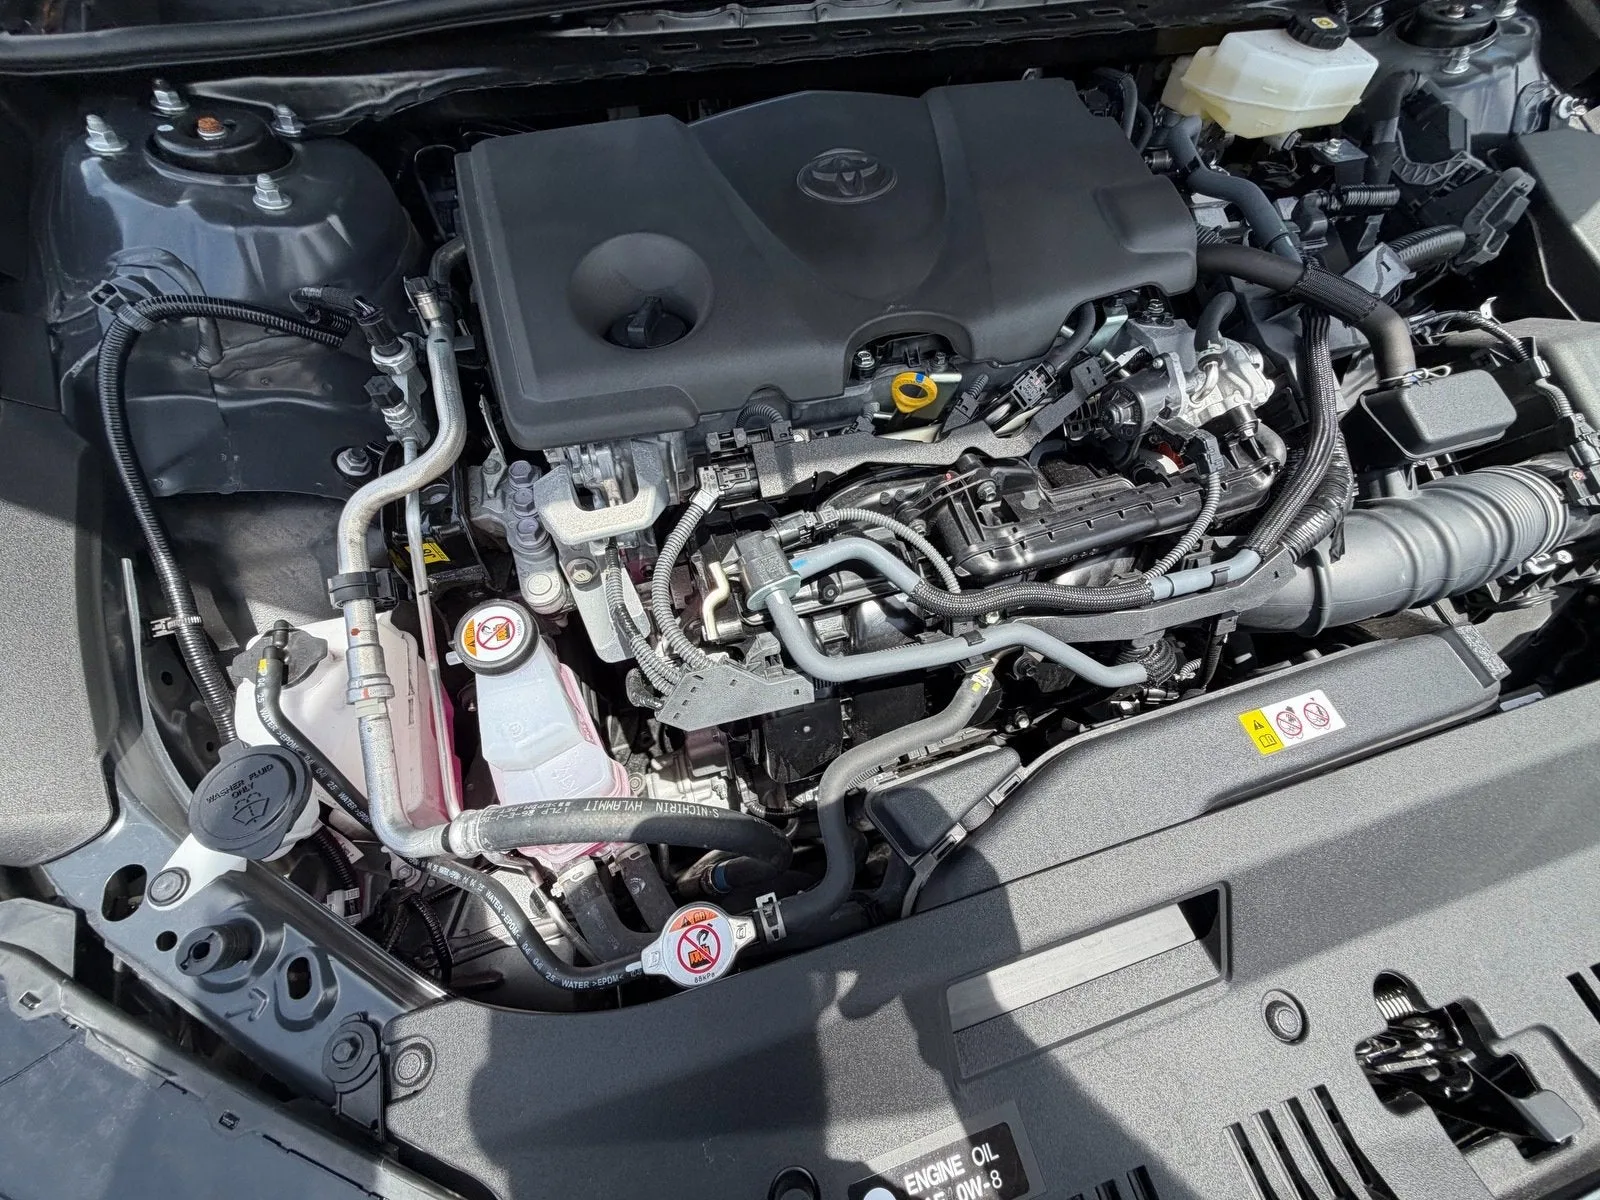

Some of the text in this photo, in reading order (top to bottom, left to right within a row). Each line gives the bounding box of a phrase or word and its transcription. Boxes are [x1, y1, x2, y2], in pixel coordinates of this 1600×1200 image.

[259, 708, 277, 734] WATER
[338, 792, 357, 814] WATER
[206, 764, 275, 804] WASHER FLUID
[231, 782, 255, 800] ONLY
[584, 800, 643, 811] HYLAMMIT
[485, 889, 503, 913] WATER
[561, 979, 590, 989] WATER
[903, 1142, 1000, 1196] ENGINE OIL
[955, 1169, 1003, 1200] 0W-8
